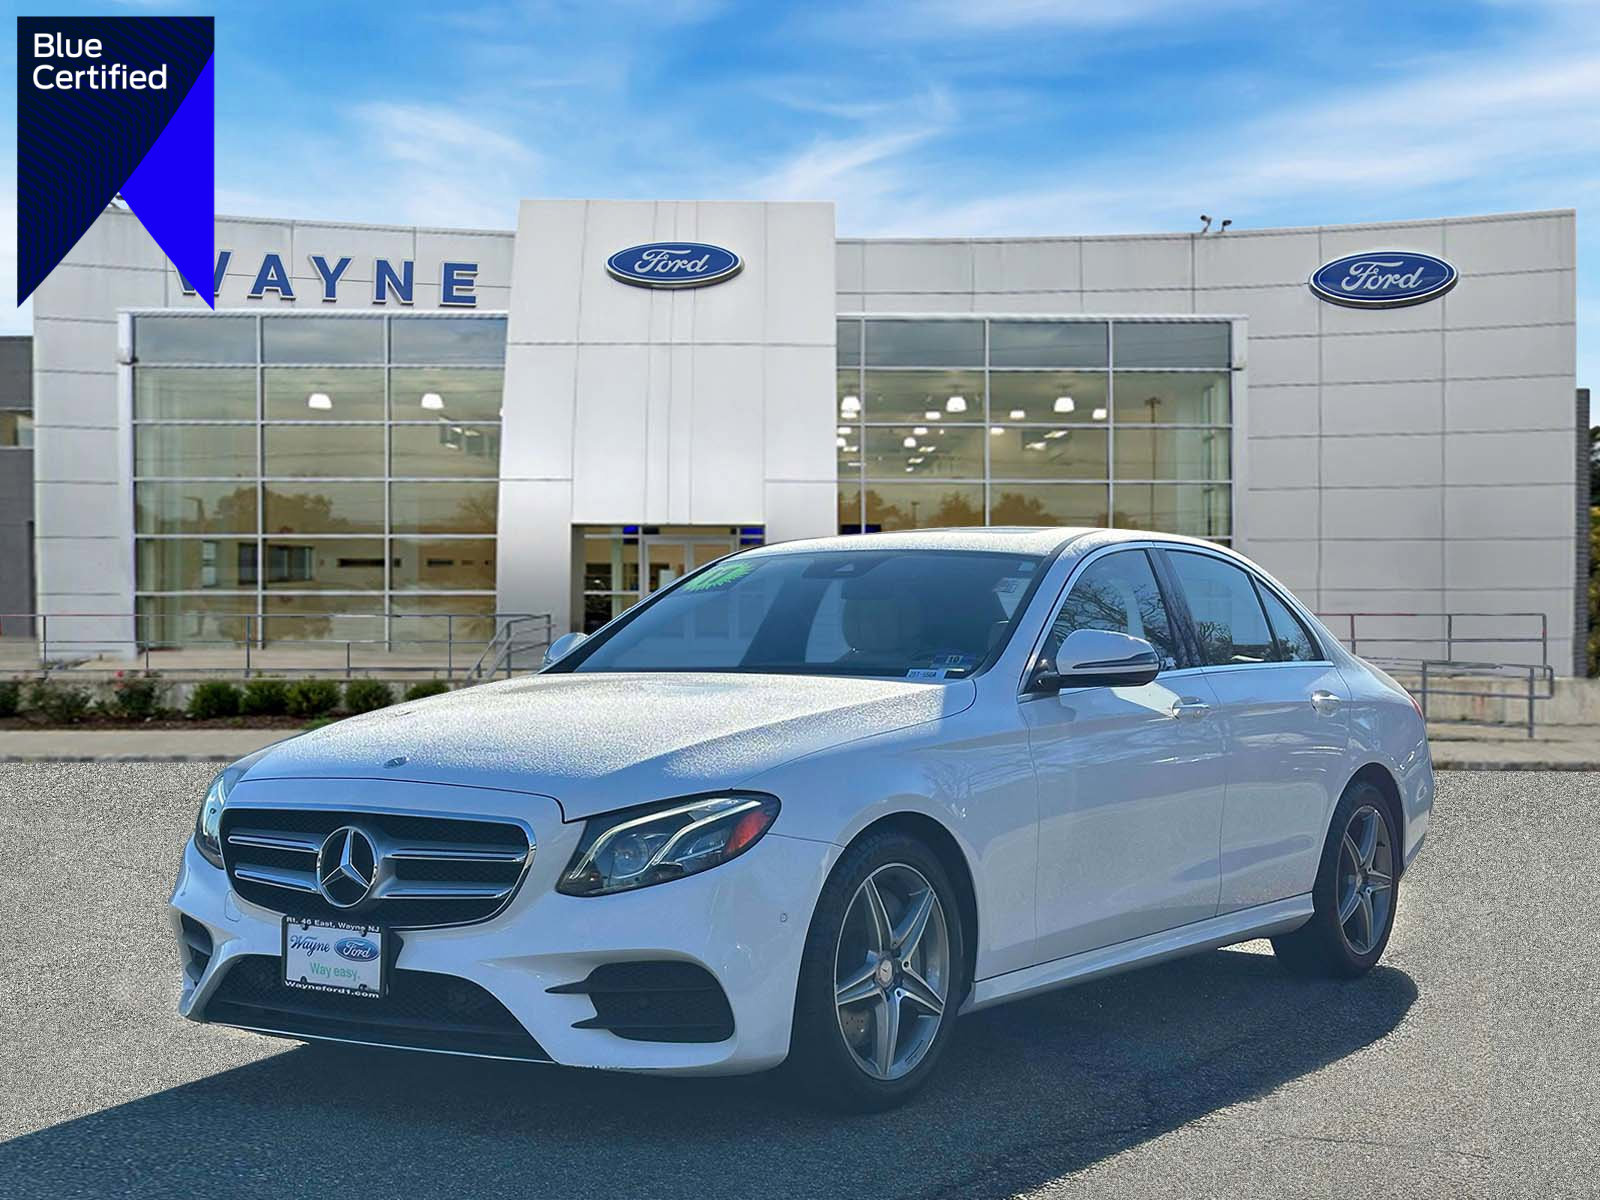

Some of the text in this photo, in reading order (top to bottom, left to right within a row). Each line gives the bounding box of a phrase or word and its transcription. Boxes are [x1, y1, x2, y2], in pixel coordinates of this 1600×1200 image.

[633, 248, 711, 273] Ford
[1341, 260, 1425, 292] Ford
[314, 919, 336, 928] East,
[338, 922, 366, 932] Wayne
[290, 935, 371, 958] Wayne Ford
[310, 961, 361, 981] Way easy.
[285, 980, 380, 999] Wayneford1.com
